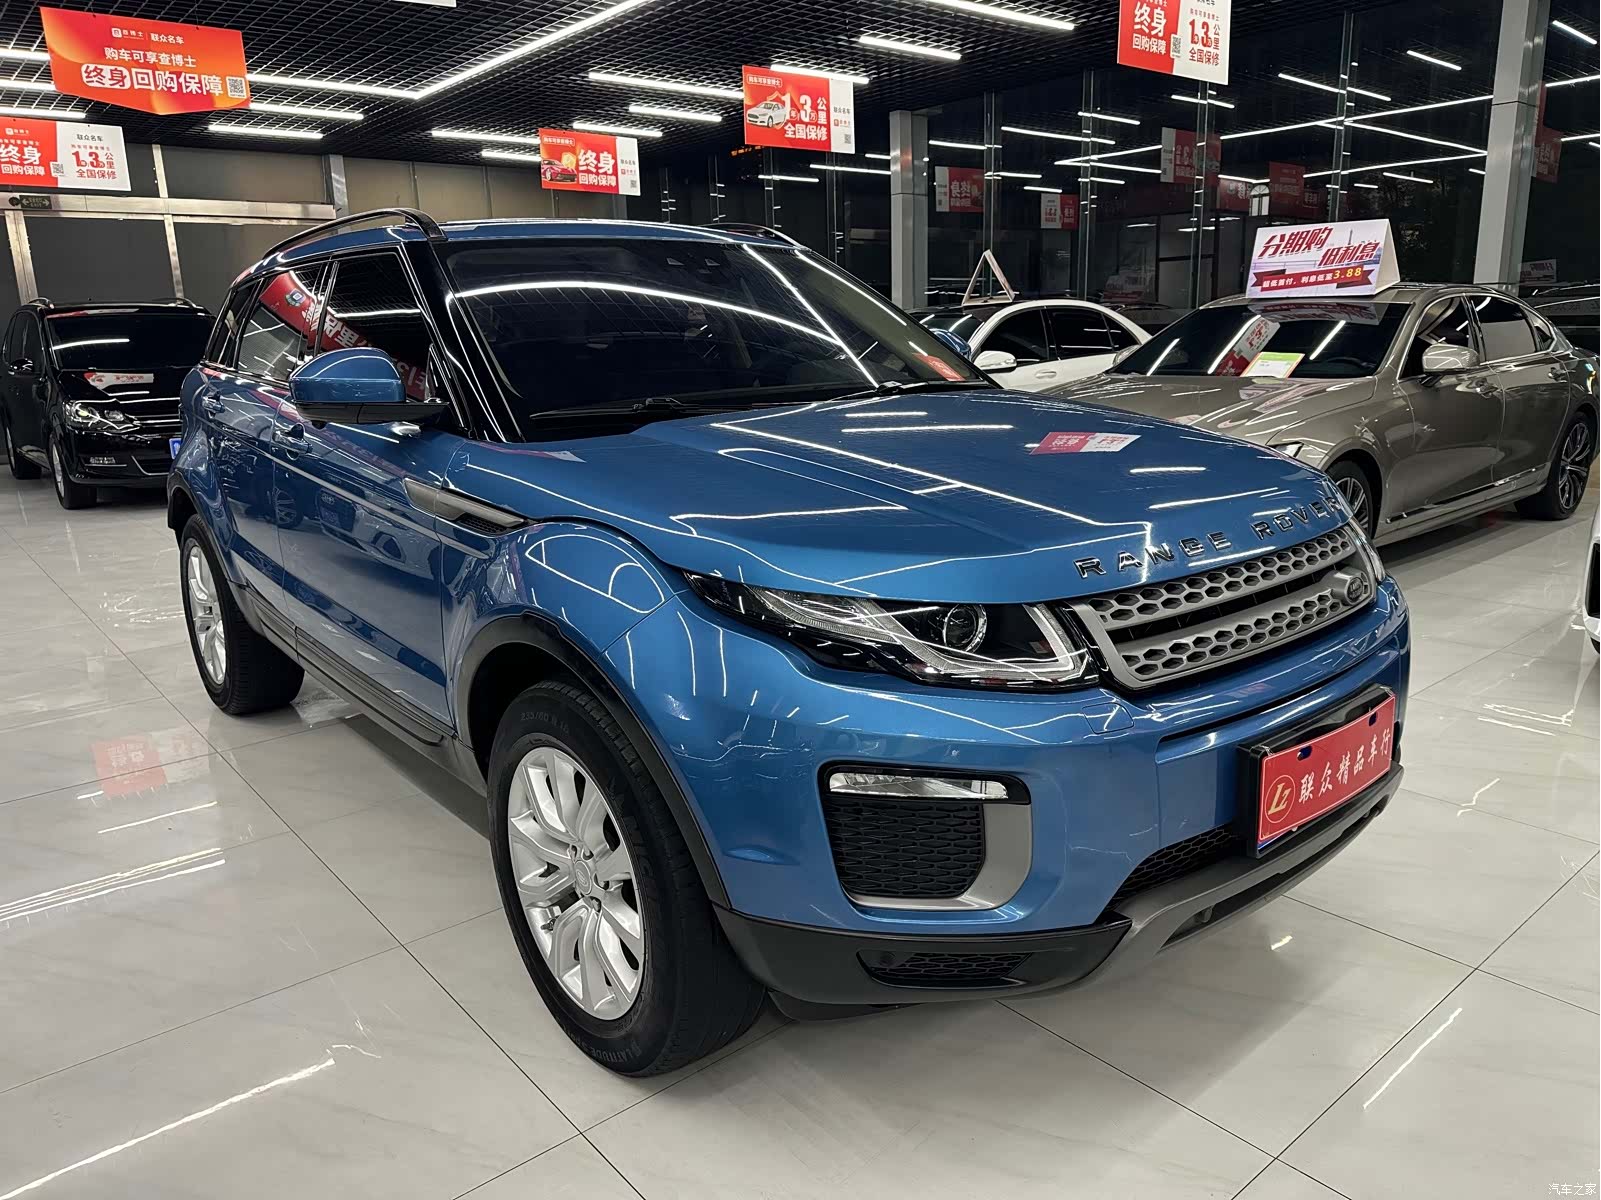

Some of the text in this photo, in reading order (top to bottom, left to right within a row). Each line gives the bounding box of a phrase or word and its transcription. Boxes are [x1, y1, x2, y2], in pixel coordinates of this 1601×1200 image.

[1134, 2, 1167, 37] 终身
[150, 32, 184, 44] 联众名车
[1132, 33, 1167, 55] 回购保障
[104, 47, 197, 68] 购车可享查博士
[1189, 47, 1220, 66] 全国保修
[84, 64, 223, 96] 终身回购保障
[784, 122, 828, 141] 全国保修
[0, 143, 41, 165] 终身
[578, 149, 615, 174] 终身
[1, 163, 46, 176] 回购保障
[76, 168, 117, 179] 全国保修
[578, 173, 617, 187] 回购保障
[1258, 226, 1334, 259] 分期购
[1318, 240, 1380, 267] 低利息
[1073, 496, 1342, 579] RANGE ROVER
[1298, 727, 1391, 805] 联众精品车行
